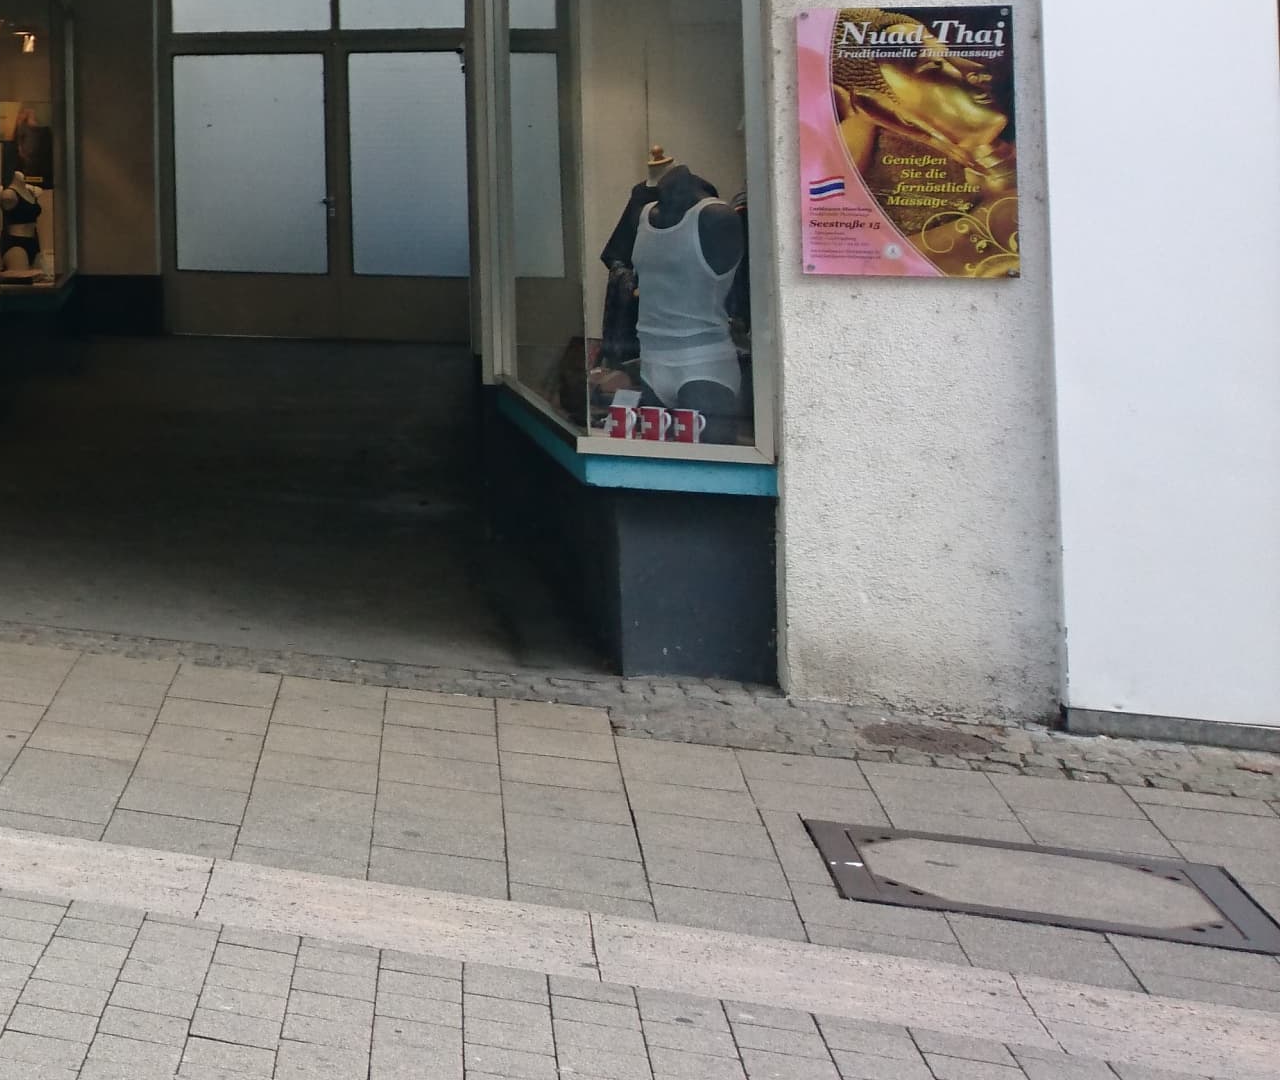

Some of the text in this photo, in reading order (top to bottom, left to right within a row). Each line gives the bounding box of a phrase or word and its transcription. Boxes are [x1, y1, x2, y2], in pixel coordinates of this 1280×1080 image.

[838, 48, 1005, 59] Traditionelle Thaimassage
[882, 155, 947, 167] Genießen
[900, 168, 947, 179] Sie die
[893, 181, 980, 194] fernöstliche
[887, 195, 949, 208] Massage
[809, 219, 865, 230] Seestraße
